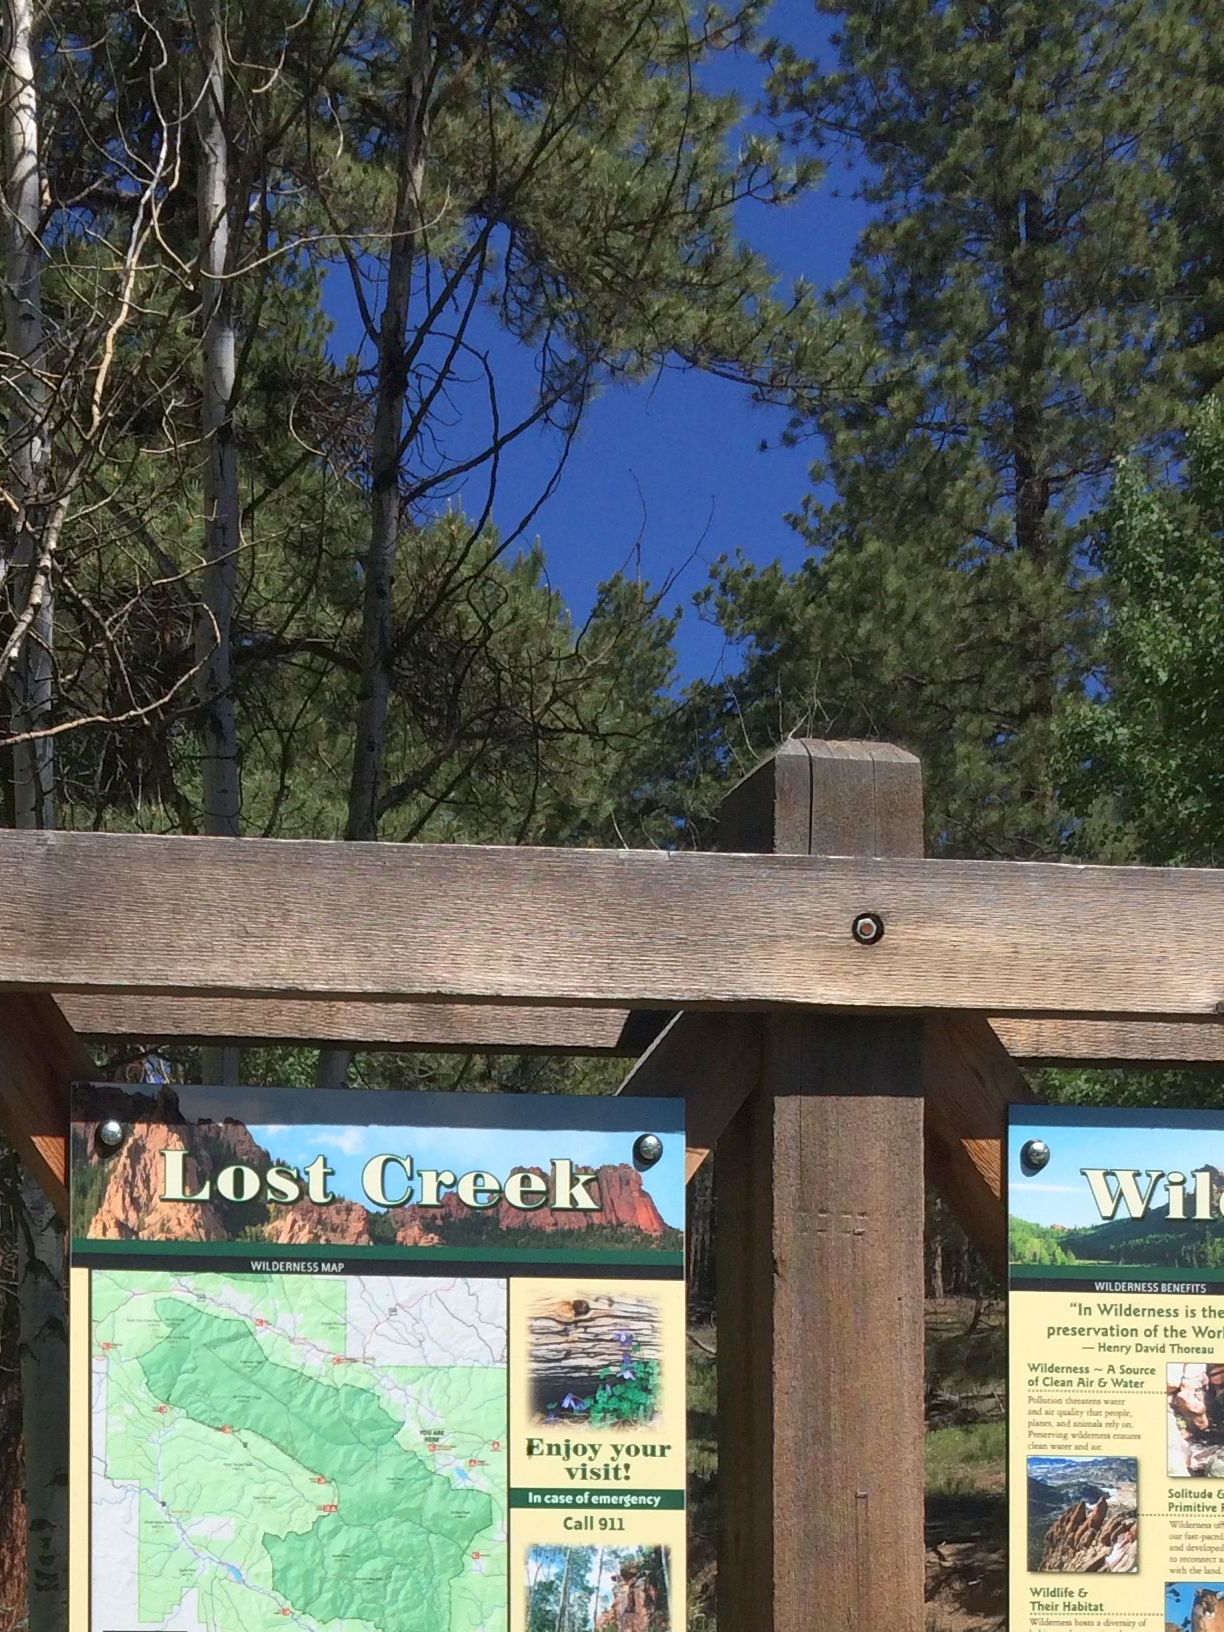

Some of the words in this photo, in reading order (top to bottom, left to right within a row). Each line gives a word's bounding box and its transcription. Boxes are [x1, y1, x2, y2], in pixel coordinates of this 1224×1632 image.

[159, 1148, 336, 1204] Lost
[361, 1153, 602, 1212] Creek
[1080, 1168, 1224, 1221] Wil
[250, 1261, 319, 1272] WILDERNESS
[321, 1262, 345, 1272] MAP
[1094, 1282, 1159, 1293] WILDERNESS
[1161, 1283, 1207, 1294] BENEFITS
[1097, 1303, 1179, 1318] Wilderness
[1185, 1305, 1197, 1318] is
[1201, 1305, 1224, 1319] the
[1047, 1324, 1138, 1339] preservation
[1144, 1324, 1159, 1338] of
[1163, 1325, 1187, 1338] the
[1098, 1342, 1132, 1355] Henry
[1135, 1343, 1166, 1354] David
[1169, 1343, 1214, 1354] Thoreau
[1027, 1363, 1090, 1375] Wilderness
[1107, 1364, 1116, 1374] A
[1119, 1364, 1156, 1375] Source
[1027, 1376, 1039, 1387] of
[1042, 1376, 1073, 1387] Clean
[1077, 1377, 1094, 1388] Air
[1097, 1377, 1108, 1388] &
[1110, 1378, 1145, 1388] Water
[526, 1438, 602, 1461] Enjoy
[610, 1444, 672, 1462] your
[564, 1463, 631, 1481] visit!
[528, 1492, 542, 1504] In
[544, 1494, 574, 1504] case
[575, 1491, 590, 1504] of
[591, 1494, 661, 1507] emergency
[1168, 1488, 1213, 1499] Solitude
[1168, 1502, 1217, 1513] Primitive
[563, 1515, 594, 1530] Call
[598, 1517, 625, 1531] 911
[1029, 1587, 1074, 1598] Wildlife
[1078, 1587, 1088, 1598] &
[1029, 1601, 1060, 1612] Their
[1063, 1601, 1105, 1612] Habitat
